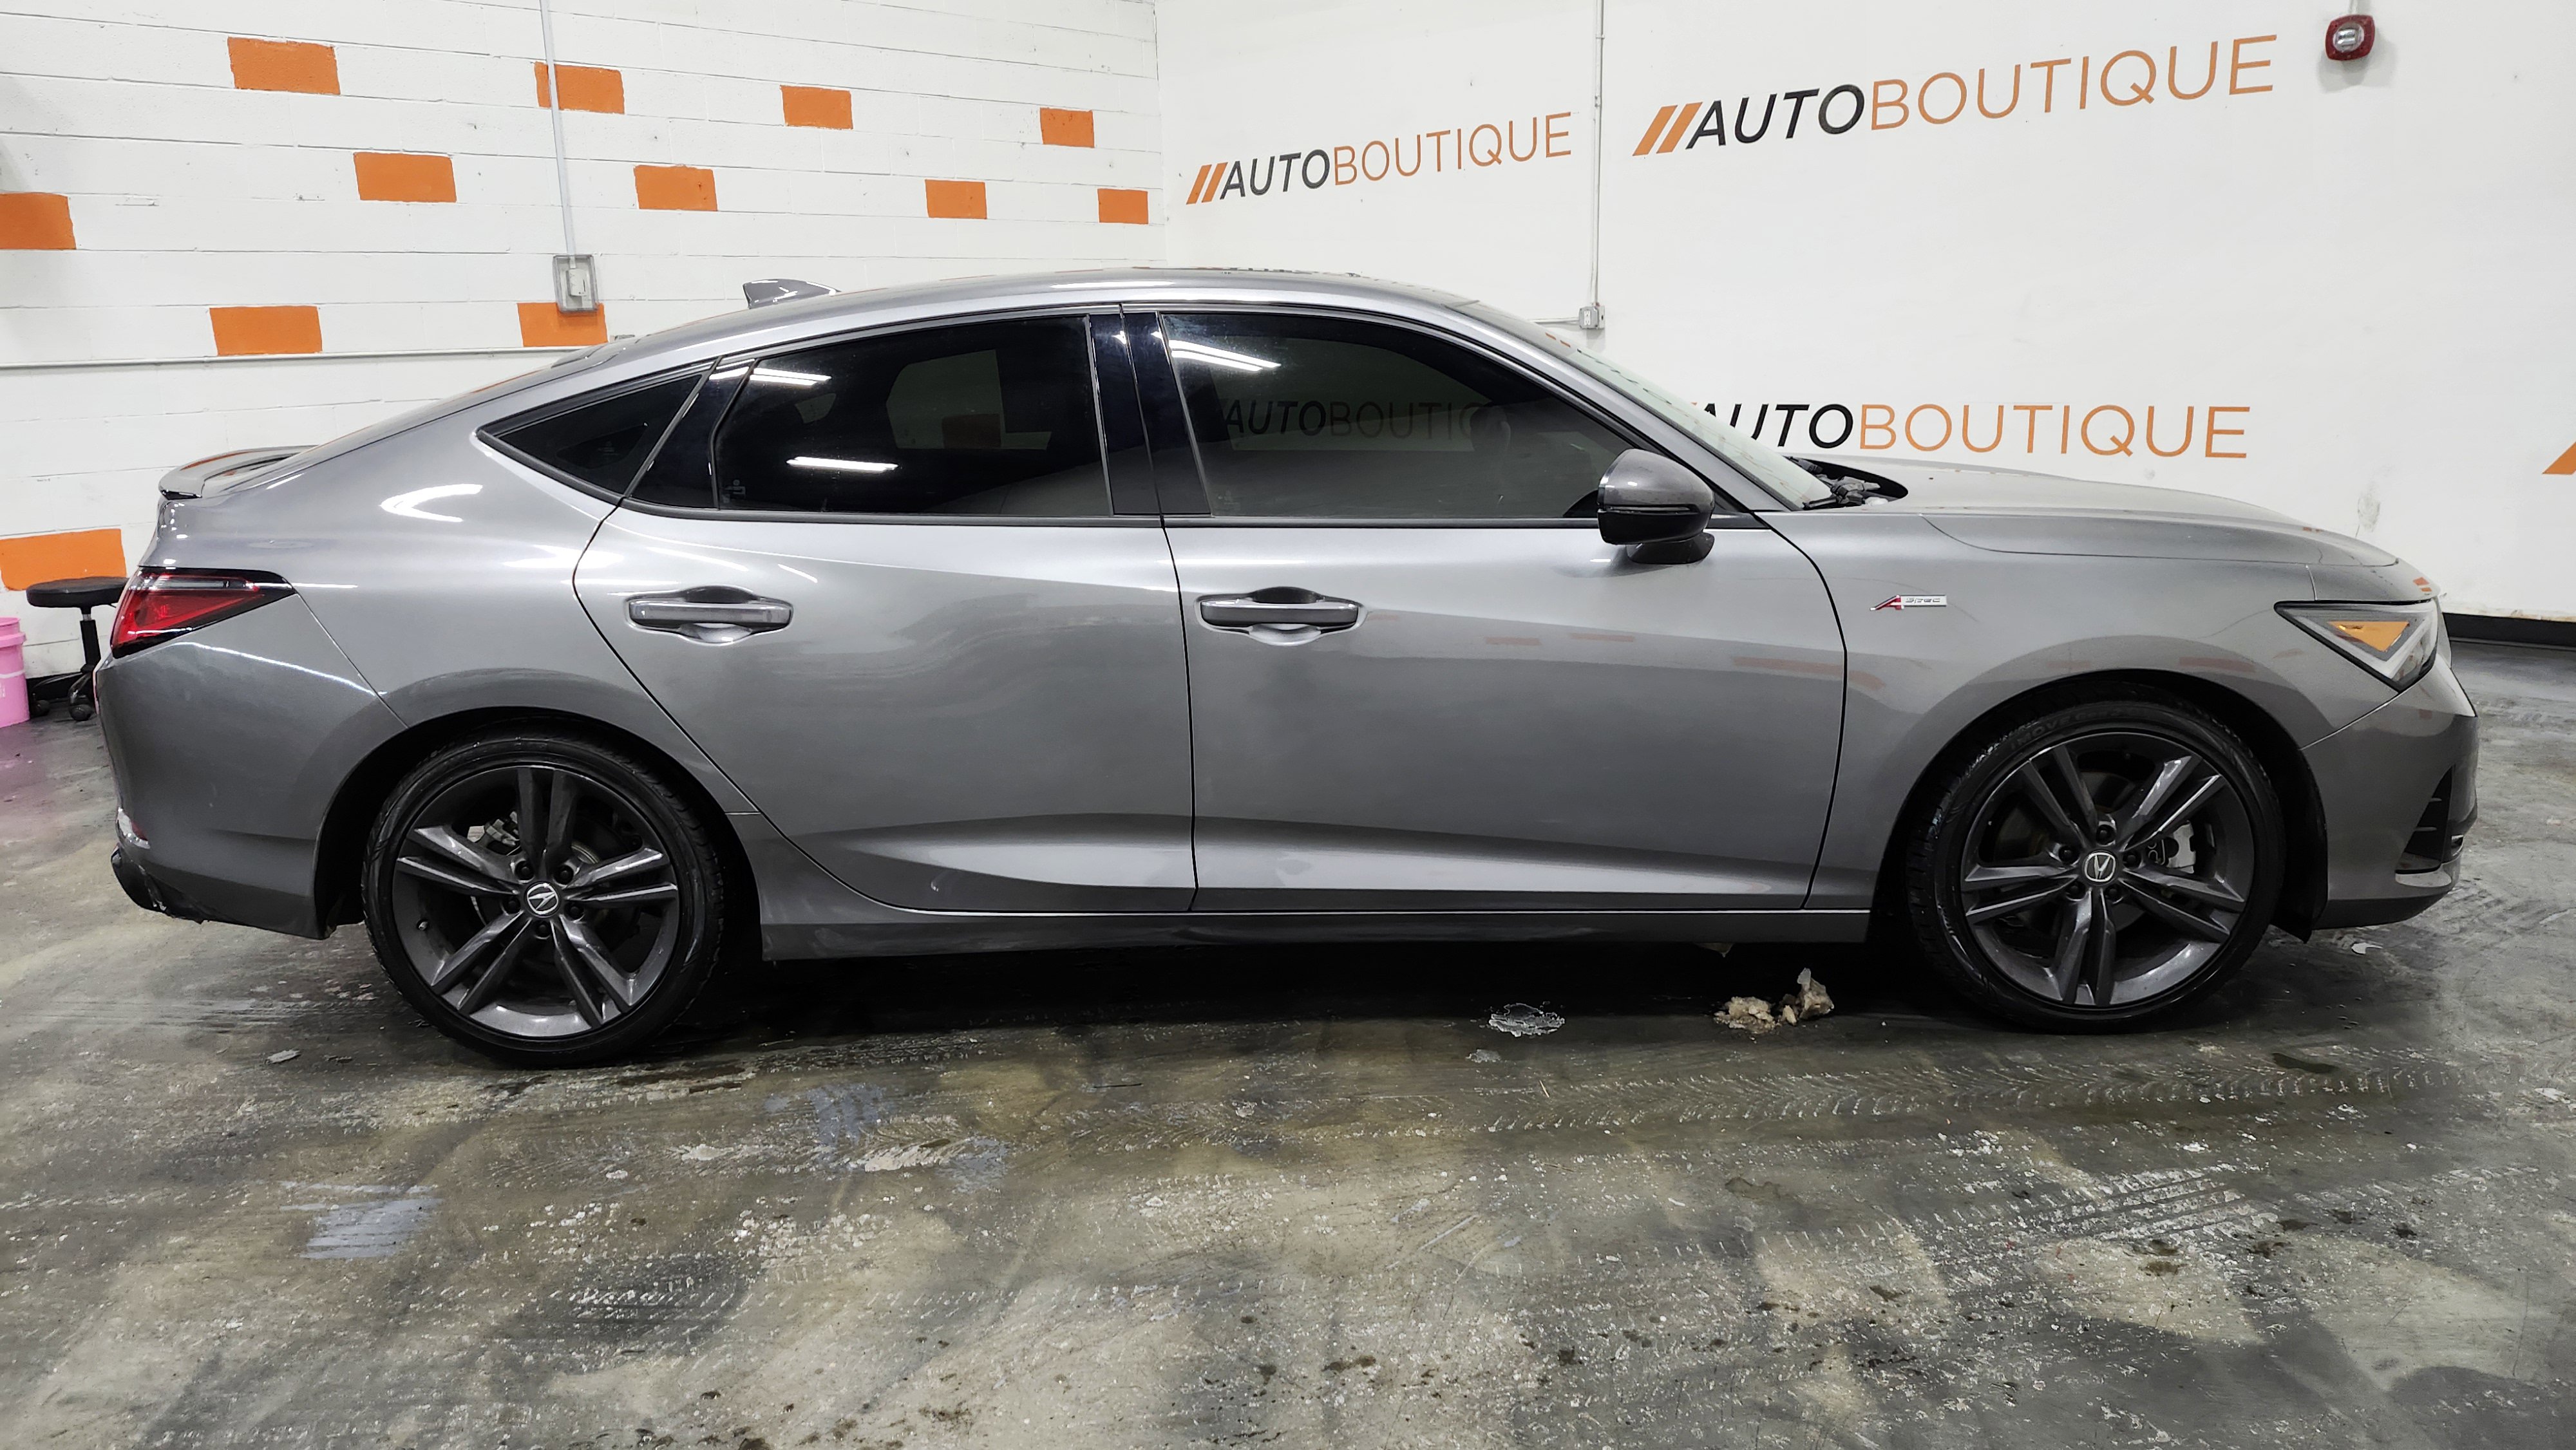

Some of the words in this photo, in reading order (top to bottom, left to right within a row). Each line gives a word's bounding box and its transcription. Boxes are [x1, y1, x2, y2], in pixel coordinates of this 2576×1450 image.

[1685, 34, 2278, 150] AUTOBOUTIQUE
[1219, 111, 1572, 201] AUTOBOUTIQUE
[1703, 403, 2251, 459] UTOBOUTIQUE
